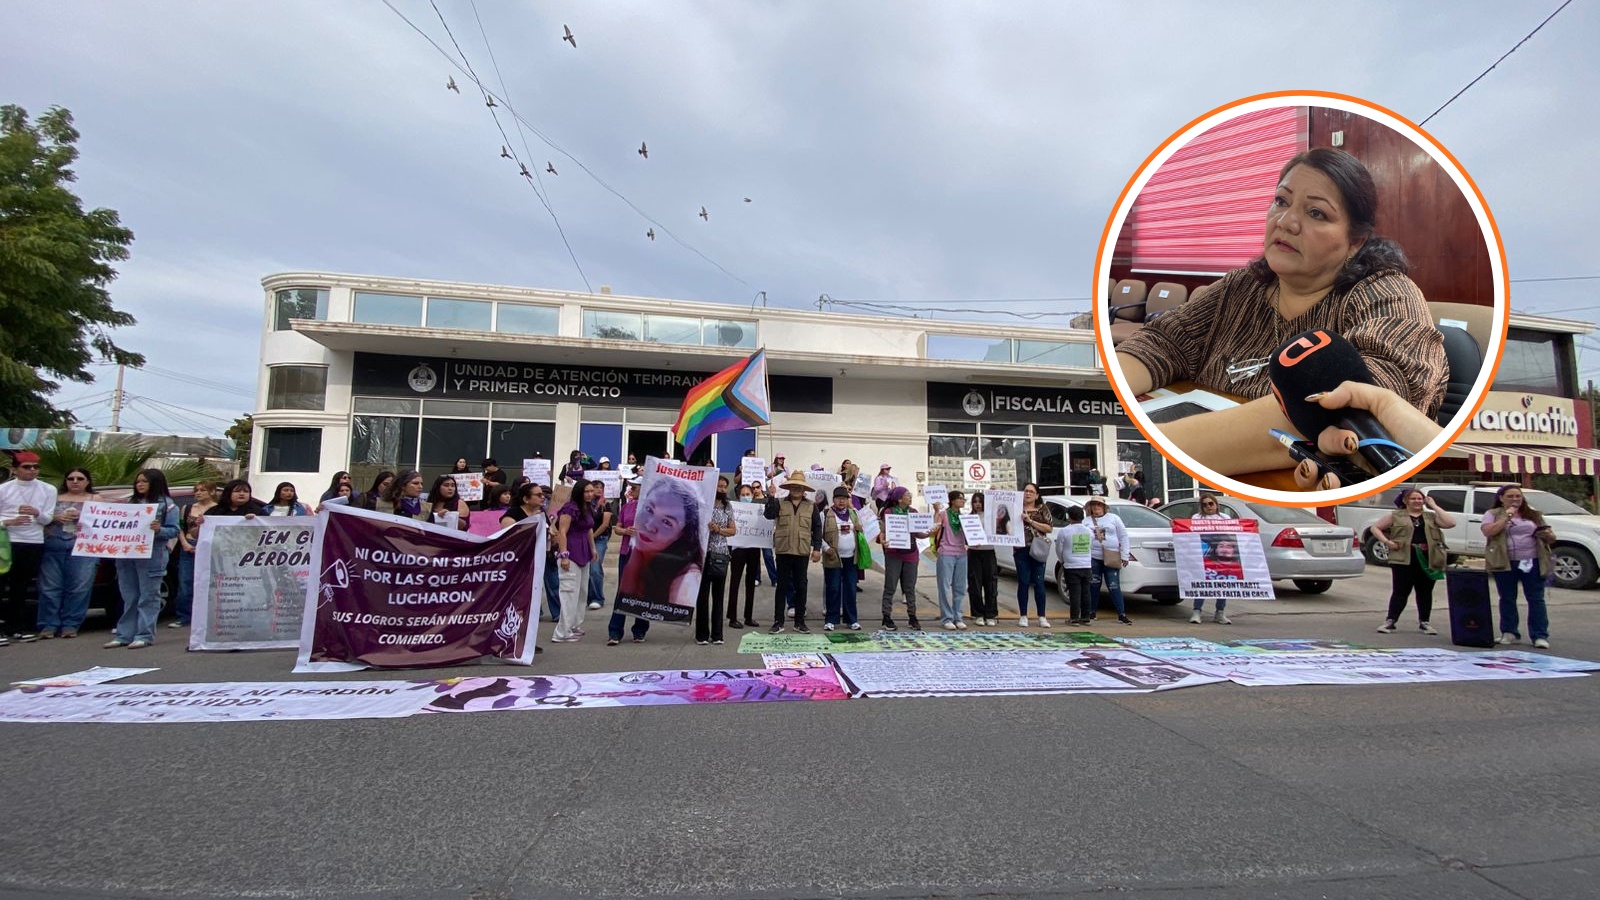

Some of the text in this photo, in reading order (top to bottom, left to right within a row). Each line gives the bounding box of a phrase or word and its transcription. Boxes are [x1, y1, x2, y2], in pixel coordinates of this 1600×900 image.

[454, 364, 519, 380] UNIDAD
[523, 367, 544, 380] DE
[550, 368, 628, 384] ATENCIÓN
[453, 379, 621, 398] Y PRIMER CONTACTO
[995, 396, 1128, 416] FISCALÍA GENE
[655, 463, 705, 481] Justicia!!
[92, 519, 139, 529] LUCHAR
[103, 534, 146, 544] SIMULAR!
[355, 547, 519, 567] NI OLVIDO NI SILENCIO.
[363, 569, 507, 588] POR LAS QUE ANTES
[1191, 581, 1213, 589] HASTA
[388, 591, 476, 605] LUCHARON.
[1199, 590, 1221, 598] HACES
[621, 597, 689, 615] exigimos justicia para
[332, 611, 499, 626] SUS LOGROS SERÁN NUESTRO
[641, 611, 664, 621] claudia
[378, 633, 447, 646] COMIENZO.
[241, 688, 279, 696] NI
